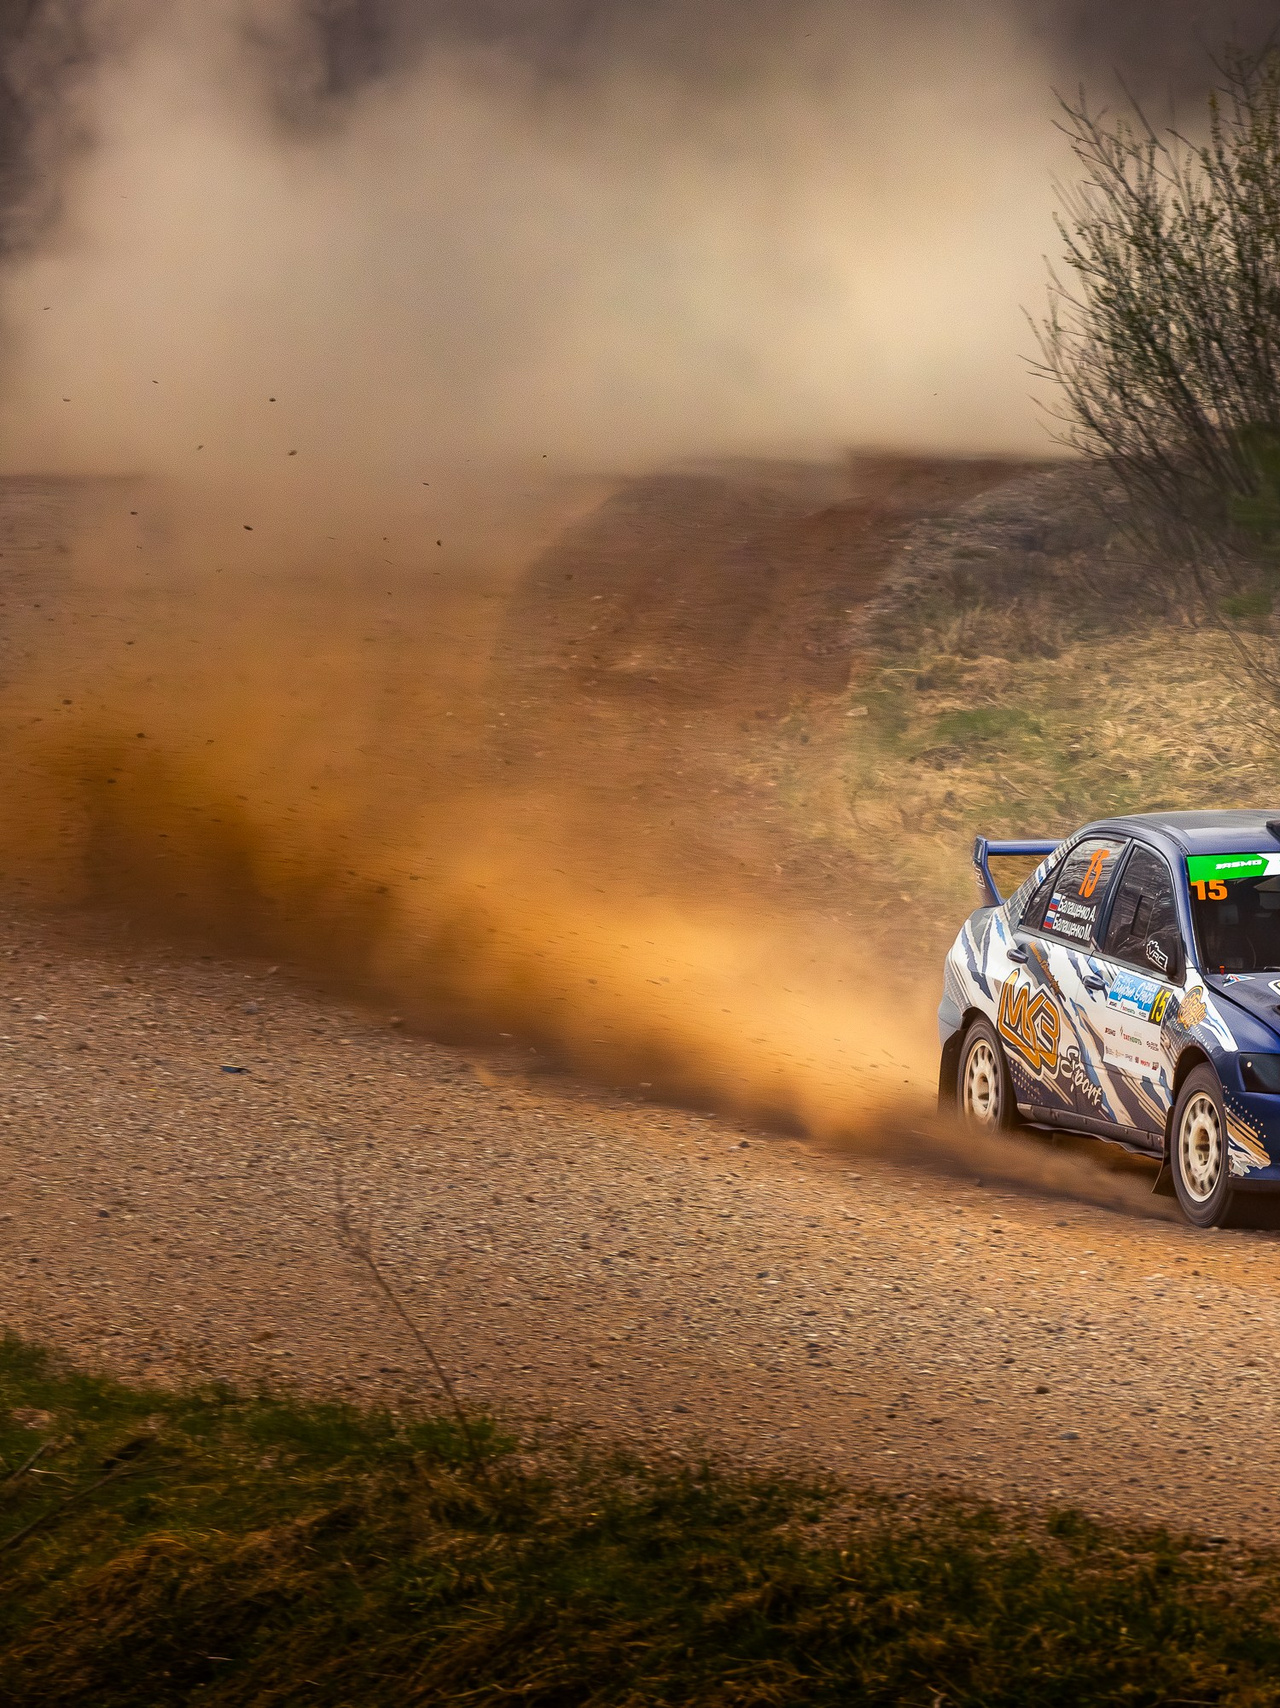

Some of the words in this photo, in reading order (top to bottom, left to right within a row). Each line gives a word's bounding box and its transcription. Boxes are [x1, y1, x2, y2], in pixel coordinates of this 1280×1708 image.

[1078, 849, 1110, 898] 15
[1190, 880, 1228, 900] 15
[1150, 989, 1171, 1022] 15
